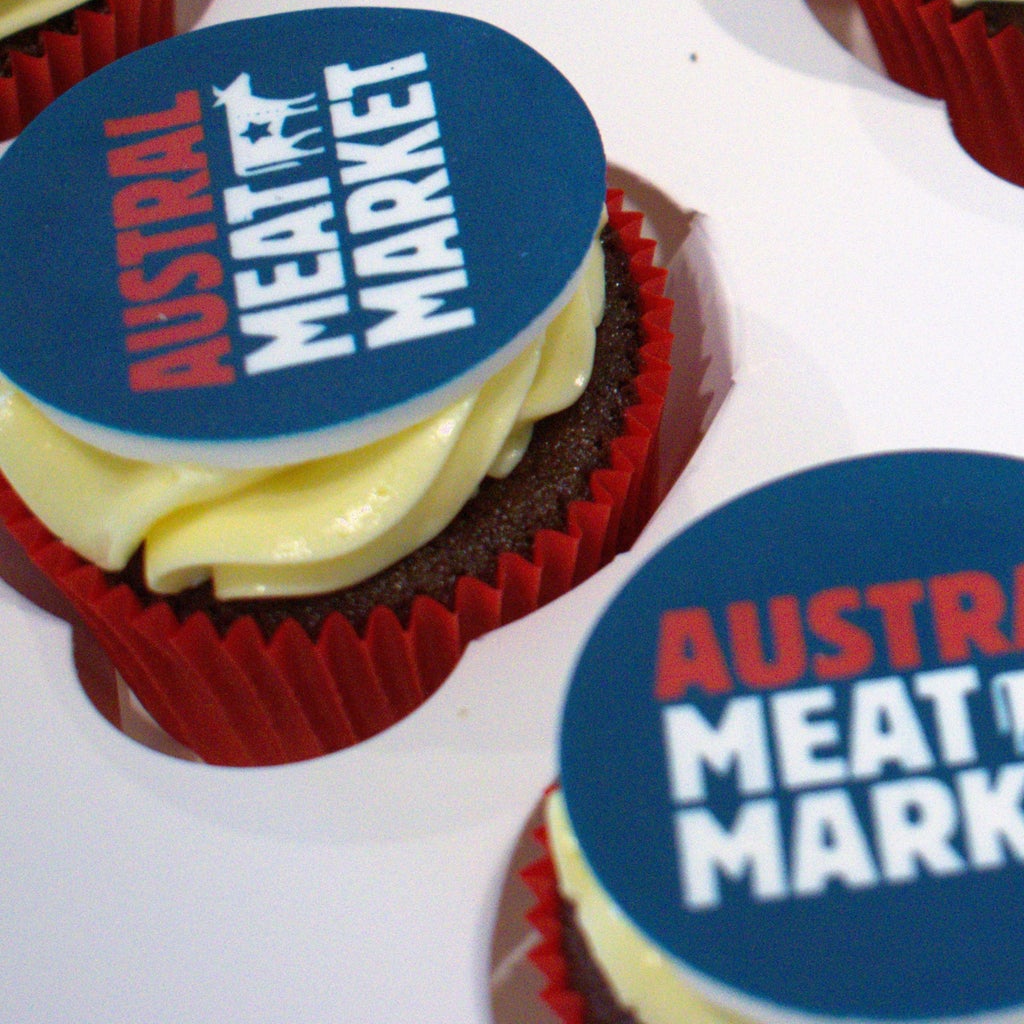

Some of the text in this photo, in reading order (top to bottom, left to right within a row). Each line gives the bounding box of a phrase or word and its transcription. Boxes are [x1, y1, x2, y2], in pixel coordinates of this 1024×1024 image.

[103, 90, 236, 393] AUSTRAL
[223, 176, 356, 375] MEAT
[324, 52, 476, 350] MARKET
[662, 665, 980, 804] MEAT
